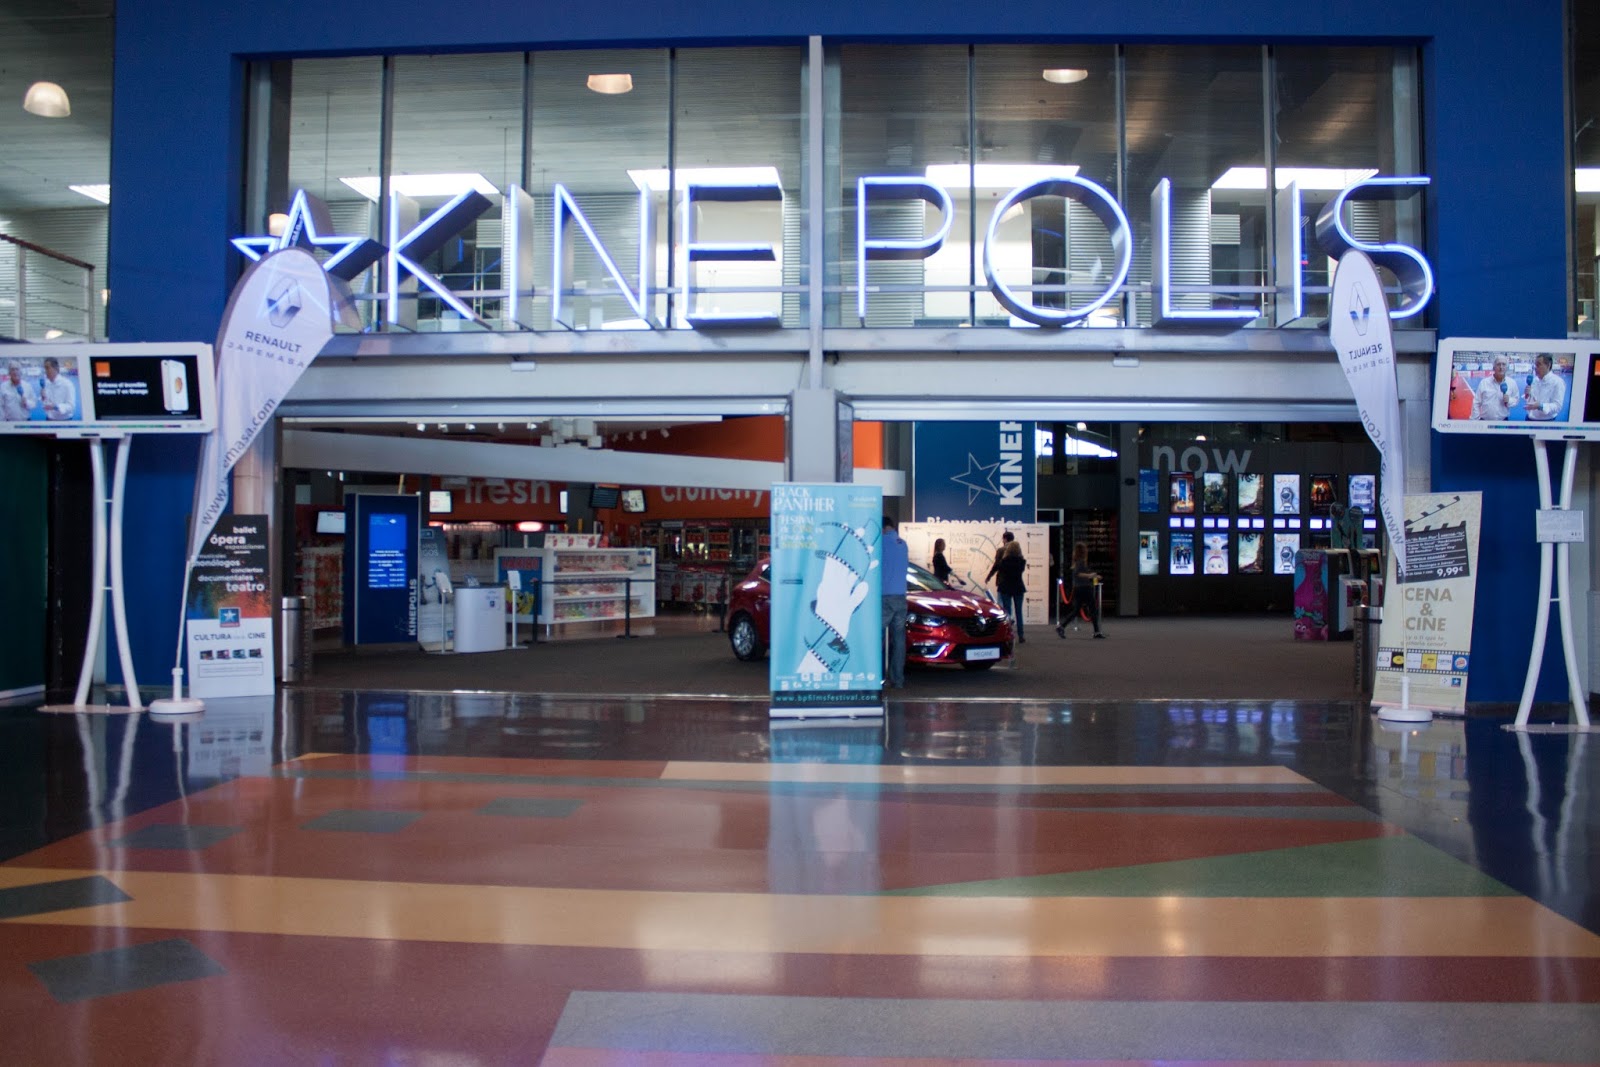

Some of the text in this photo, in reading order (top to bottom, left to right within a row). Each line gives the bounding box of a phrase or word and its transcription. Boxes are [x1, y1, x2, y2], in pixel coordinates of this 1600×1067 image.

[245, 331, 302, 354] RENAULT
[1152, 445, 1253, 479] now
[774, 486, 811, 498] BLACK
[773, 496, 836, 512] PANTHER
[232, 525, 258, 535] ballet
[209, 533, 247, 547] ópera
[197, 574, 255, 582] documentales
[1436, 566, 1464, 578] 9,99€
[225, 581, 266, 593] teatro
[1404, 587, 1453, 602] CENA
[408, 578, 418, 636] KINEPOLIS
[1420, 603, 1433, 616] &
[1405, 616, 1447, 632] CINE
[193, 633, 232, 641] CULTURA
[247, 632, 267, 640] CINE
